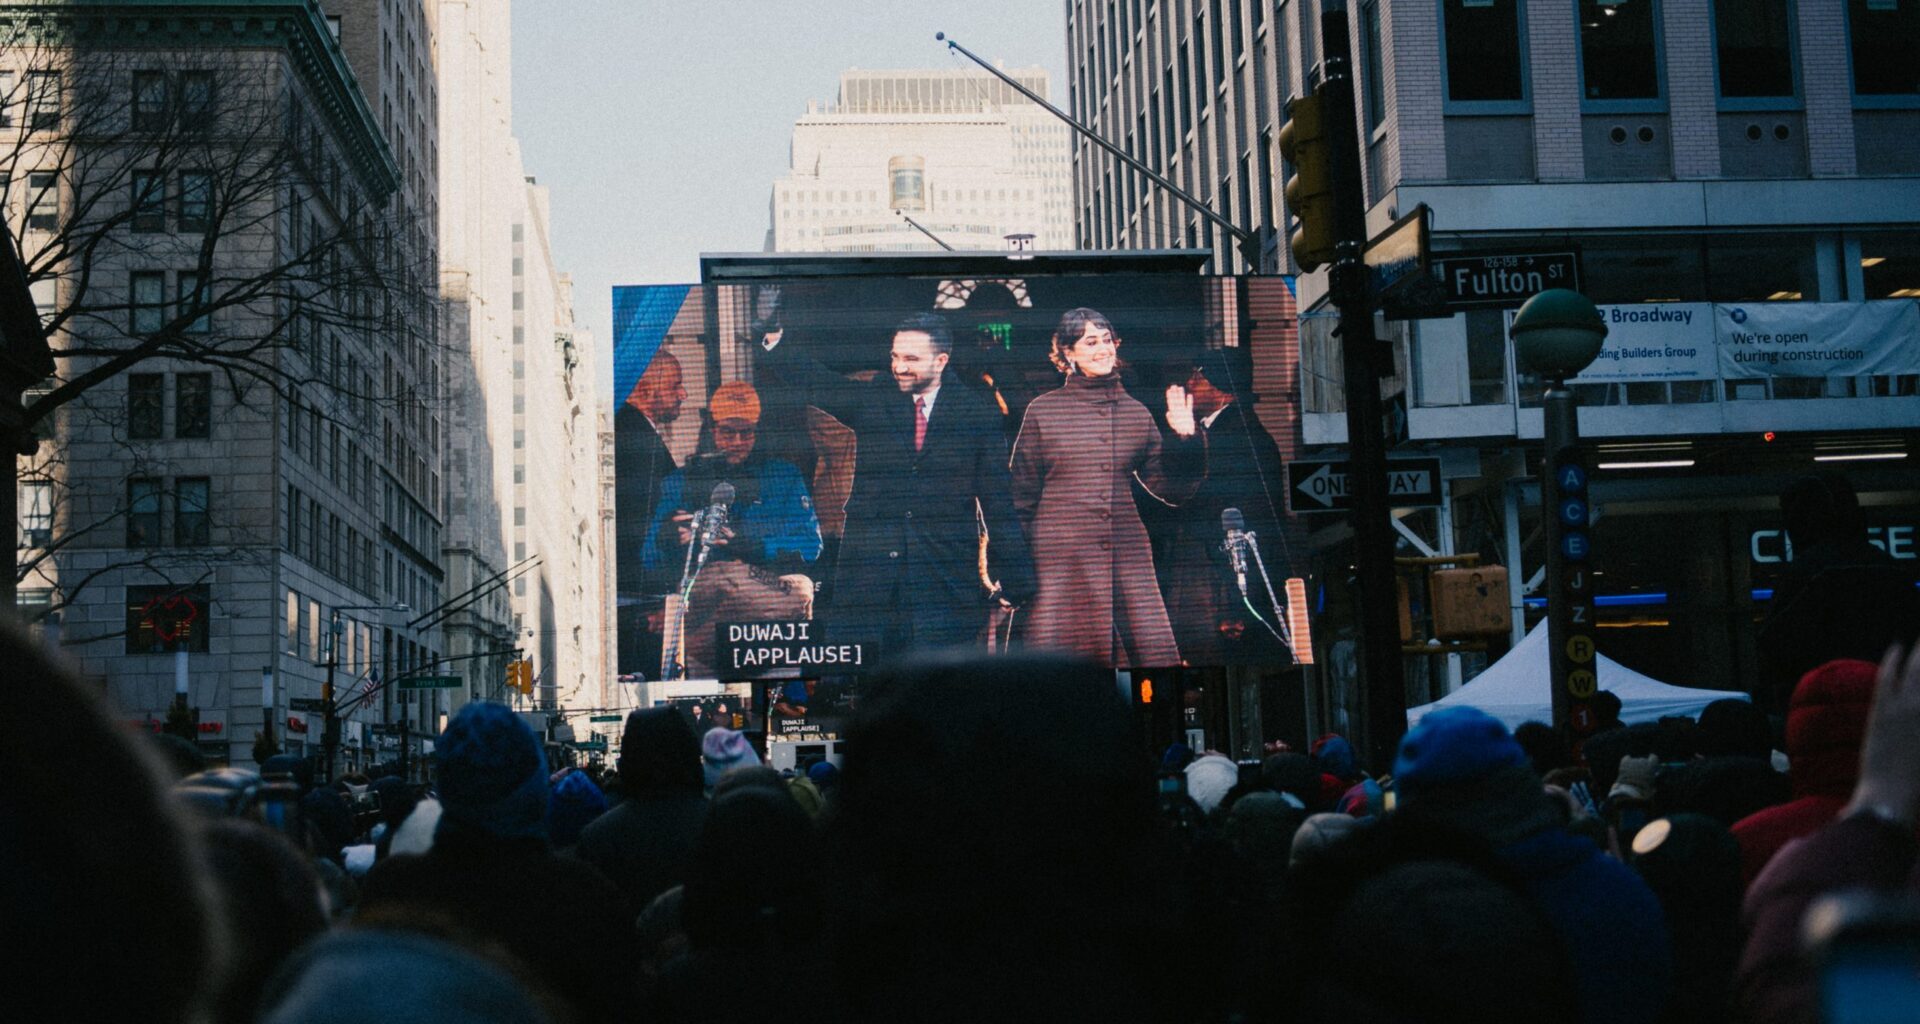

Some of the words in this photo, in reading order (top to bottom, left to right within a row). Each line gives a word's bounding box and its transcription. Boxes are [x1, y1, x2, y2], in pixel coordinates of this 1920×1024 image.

[1483, 257, 1518, 268] 126-158
[1455, 268, 1543, 295] Fulton
[1549, 263, 1565, 279] ST
[1612, 307, 1692, 325] Broadway
[1732, 333, 1771, 345] We're
[1775, 332, 1808, 346] open
[1622, 348, 1662, 359] Builders
[1665, 347, 1697, 359] Group
[1734, 350, 1779, 364] during
[1782, 348, 1864, 361] construction
[1313, 476, 1352, 495] ONE
[1388, 473, 1421, 493] AY
[1565, 469, 1580, 486] A
[1566, 503, 1581, 520] C
[1568, 537, 1582, 554] E
[1571, 571, 1583, 589] J
[1572, 606, 1586, 623] Z
[729, 623, 809, 642] DUWAJI
[733, 644, 862, 668] [APPLAUSE]
[1574, 641, 1587, 657] R
[1572, 677, 1591, 692] W
[1578, 709, 1589, 727] 1
